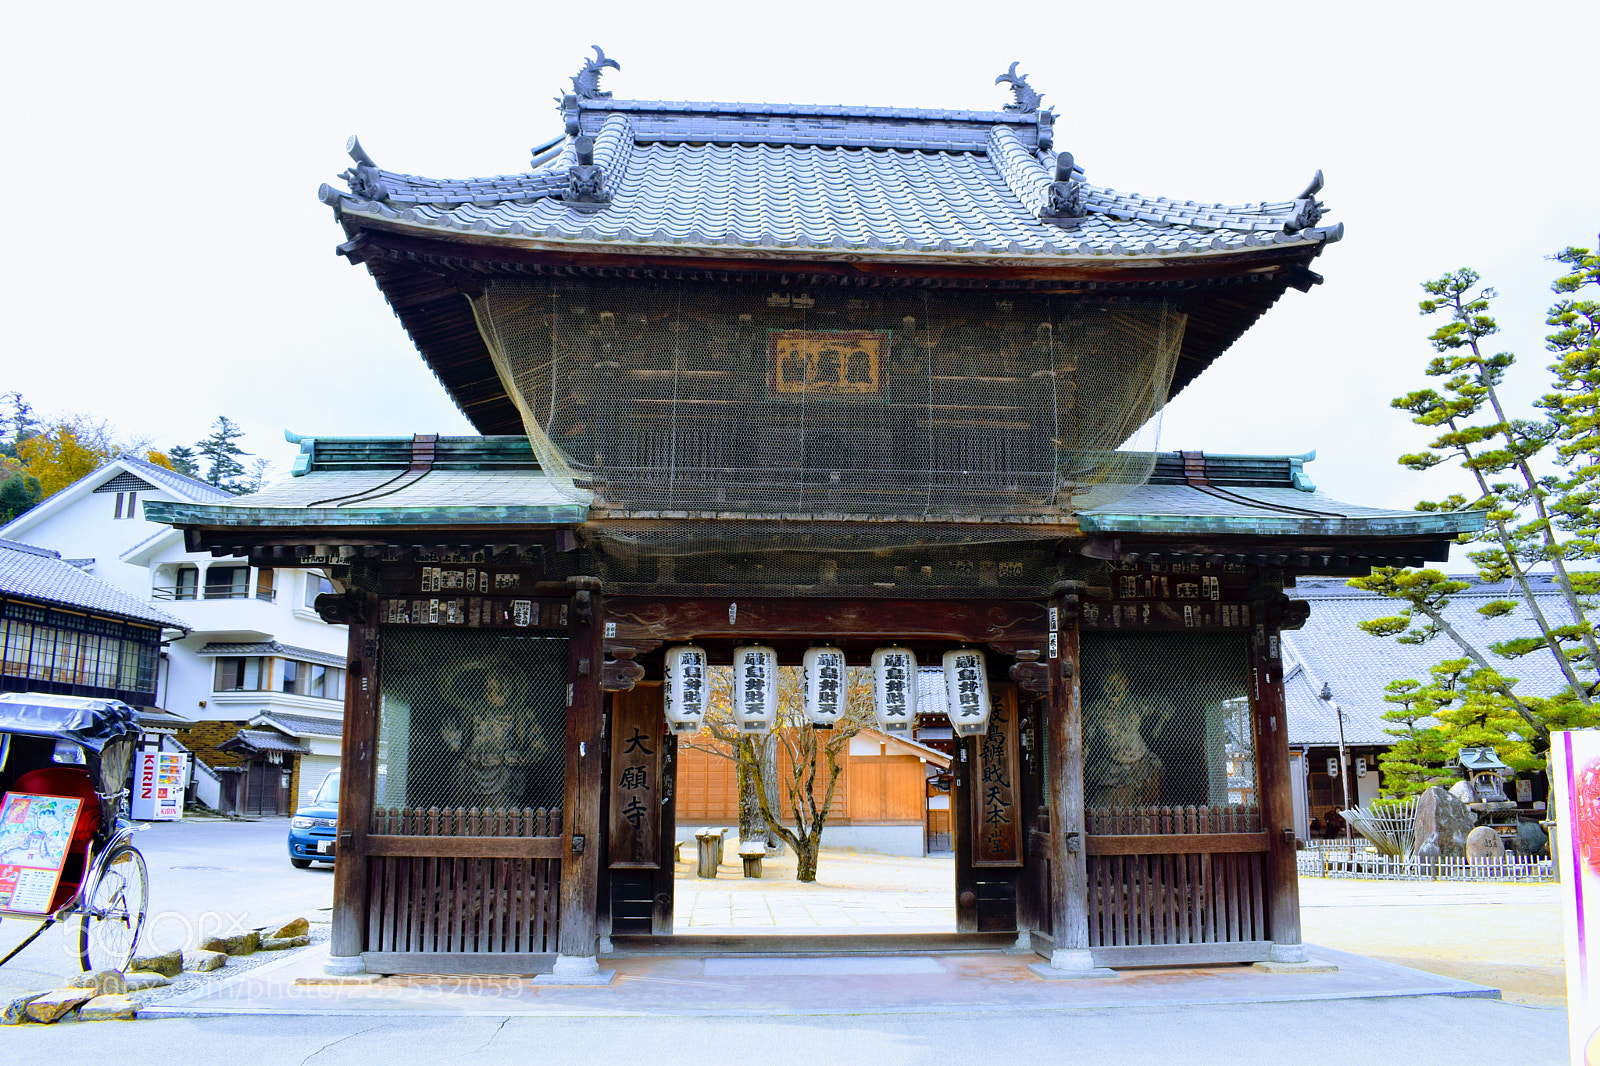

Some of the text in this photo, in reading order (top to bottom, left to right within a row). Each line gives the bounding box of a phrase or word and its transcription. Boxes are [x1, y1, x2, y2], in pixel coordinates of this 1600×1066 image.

[141, 754, 155, 799] KIRIN
[618, 727, 655, 831] 大願寺
